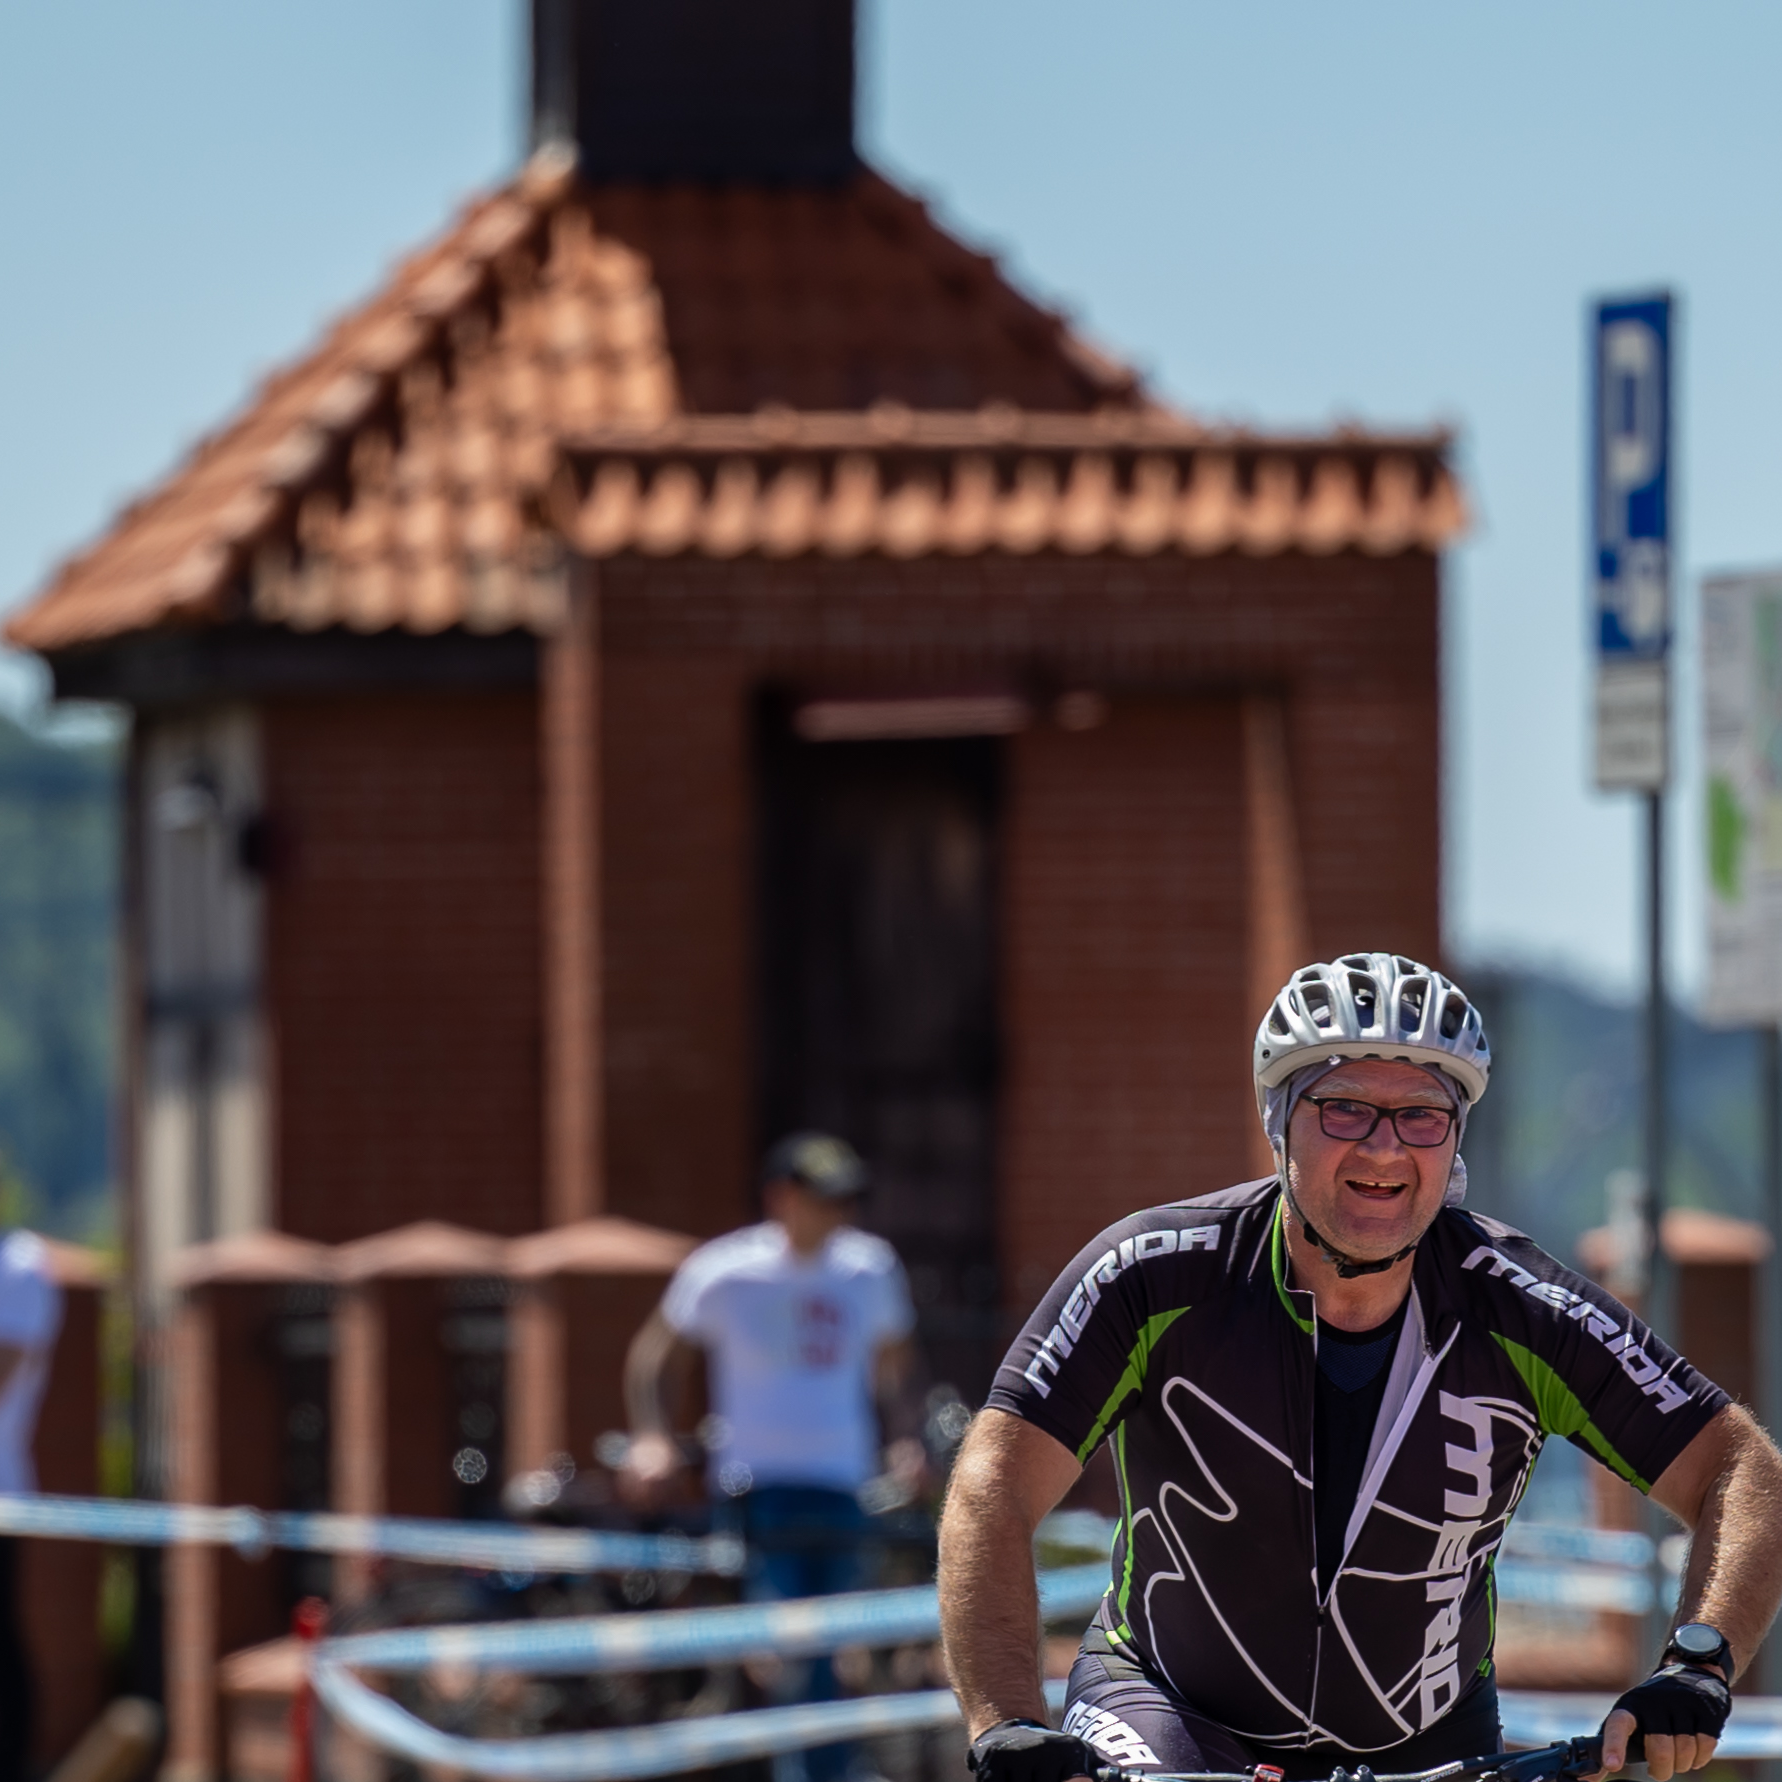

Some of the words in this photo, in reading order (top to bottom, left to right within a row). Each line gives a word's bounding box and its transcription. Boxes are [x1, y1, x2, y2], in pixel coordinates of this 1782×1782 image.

[1024, 1224, 1221, 1399] MERIDA
[1461, 1246, 1691, 1414] MERIDA
[1419, 1390, 1494, 1733] MERID
